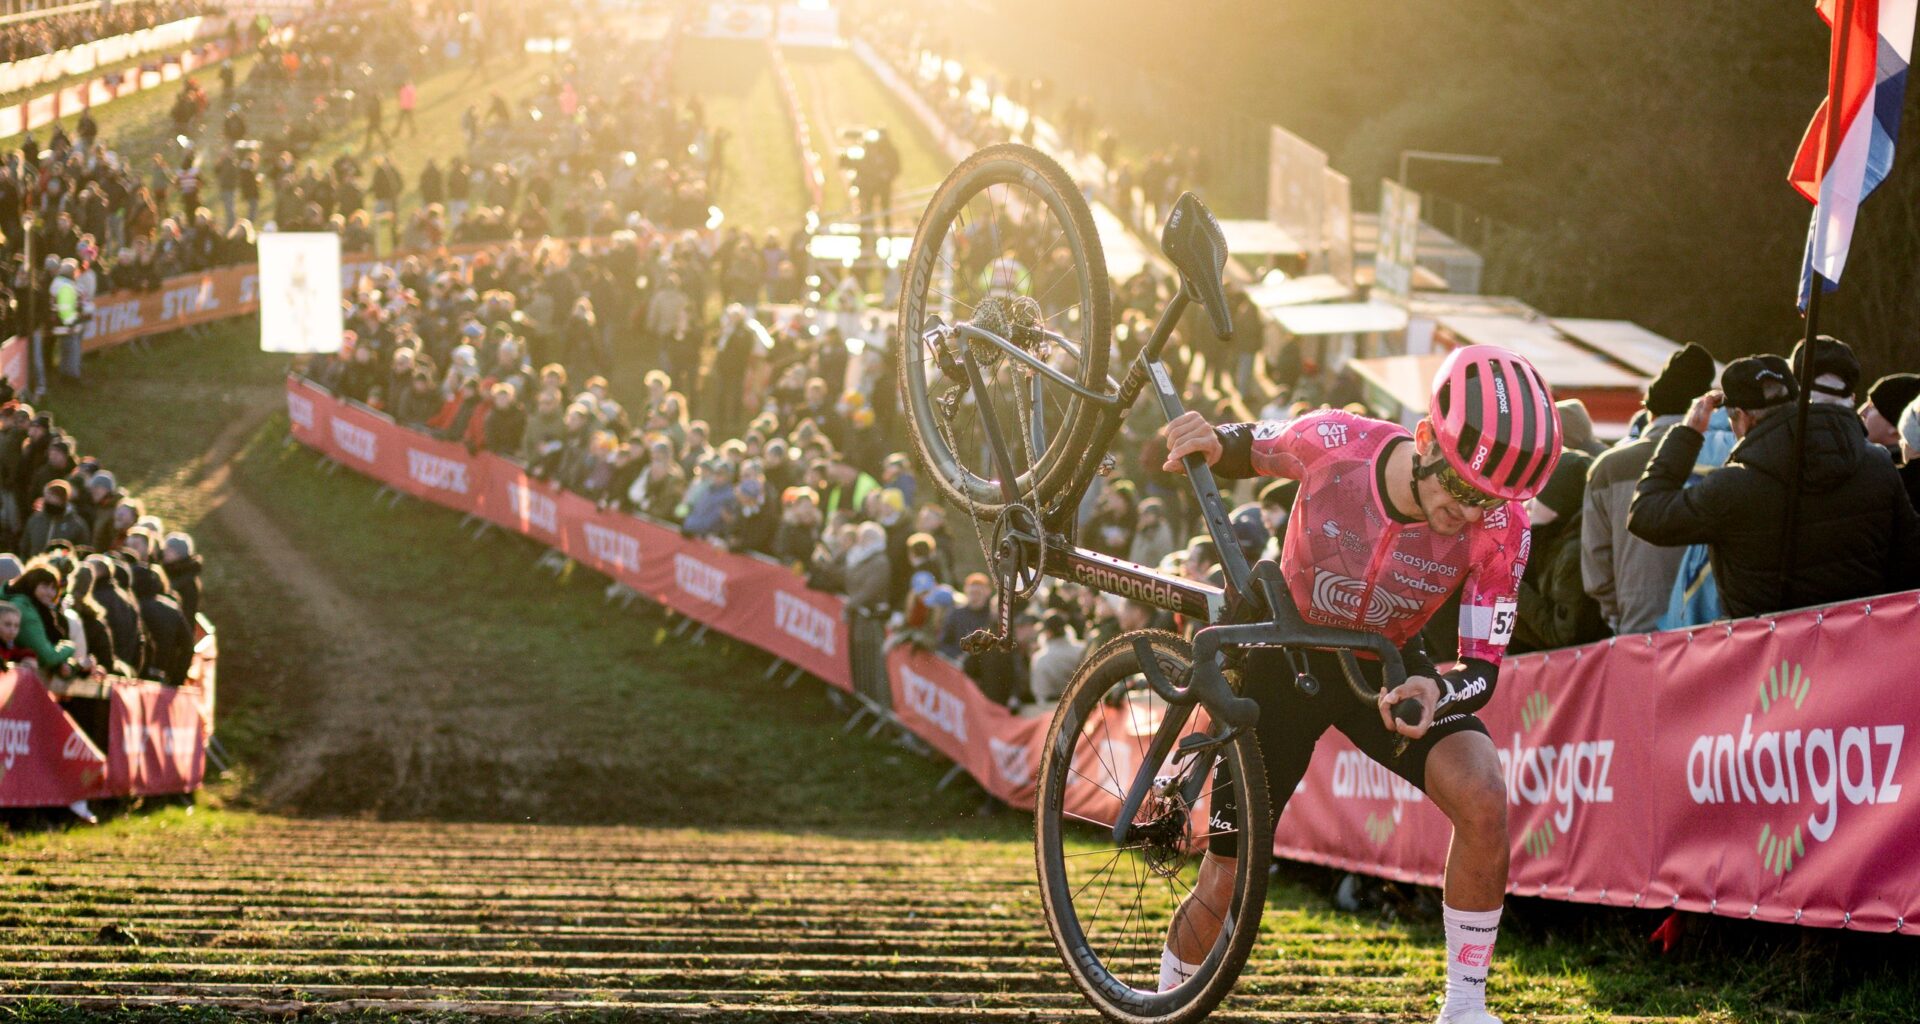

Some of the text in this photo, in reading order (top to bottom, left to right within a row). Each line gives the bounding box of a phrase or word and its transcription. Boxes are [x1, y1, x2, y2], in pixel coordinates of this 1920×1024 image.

[161, 284, 220, 320] STIHL
[1494, 377, 1509, 414] easypost
[1392, 551, 1458, 577] easypost
[1393, 571, 1447, 593] wahoo
[1075, 563, 1182, 610] cannondale
[1002, 574, 1010, 638] SRAM
[1455, 676, 1487, 702] wahoo
[1497, 732, 1615, 834] ntargaz
[1687, 713, 1905, 843] antargaz
